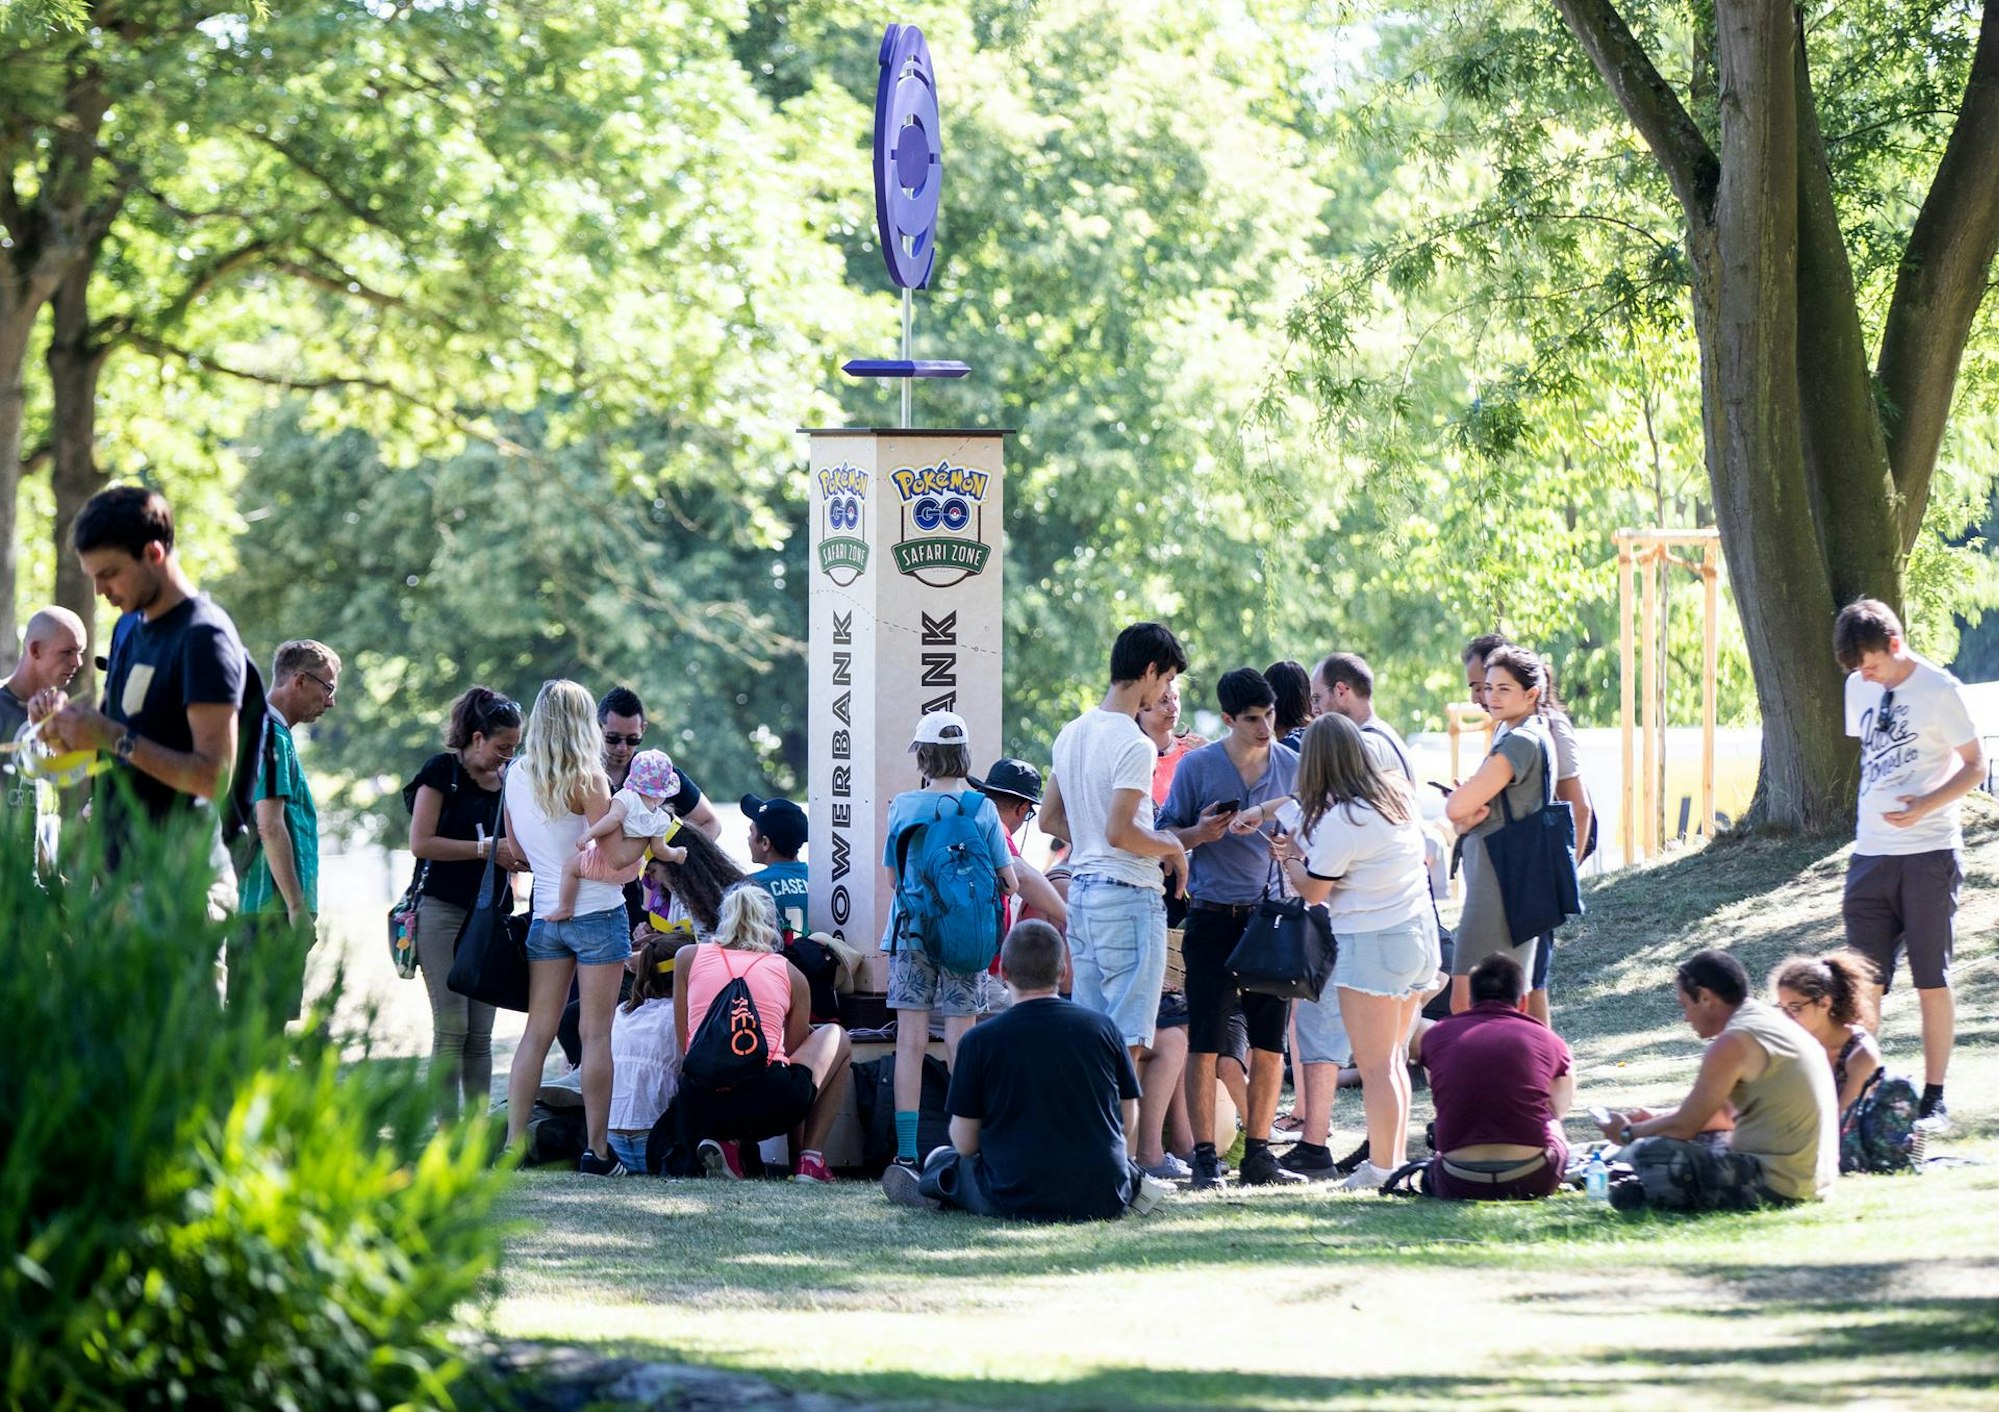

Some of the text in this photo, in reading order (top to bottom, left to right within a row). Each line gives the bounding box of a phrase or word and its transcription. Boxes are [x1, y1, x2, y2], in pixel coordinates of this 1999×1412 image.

[829, 497, 858, 530] GO
[913, 497, 970, 530] GO
[822, 543, 866, 566] SAFARI ZONE
[902, 544, 982, 566] SAFARI ZONE
